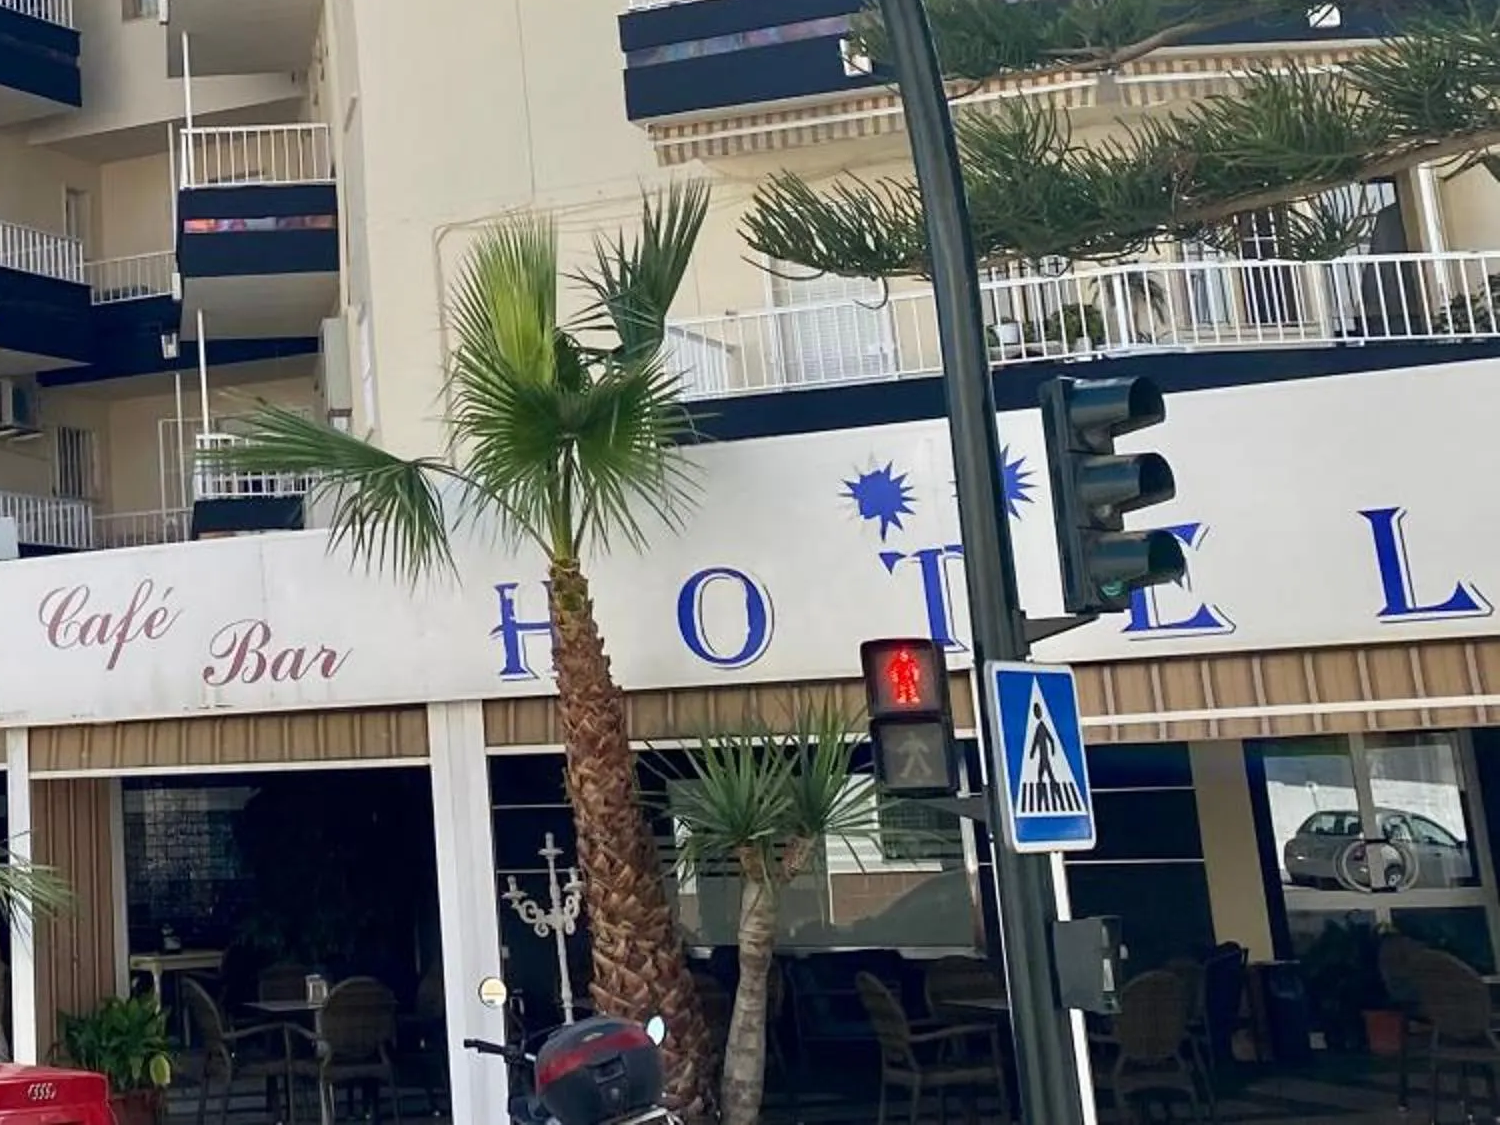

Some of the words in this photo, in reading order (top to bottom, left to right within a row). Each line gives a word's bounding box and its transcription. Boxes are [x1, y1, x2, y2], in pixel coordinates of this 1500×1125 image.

[38, 578, 184, 671] Café
[203, 618, 354, 686] Bar
[488, 506, 1492, 681] HOTEL
